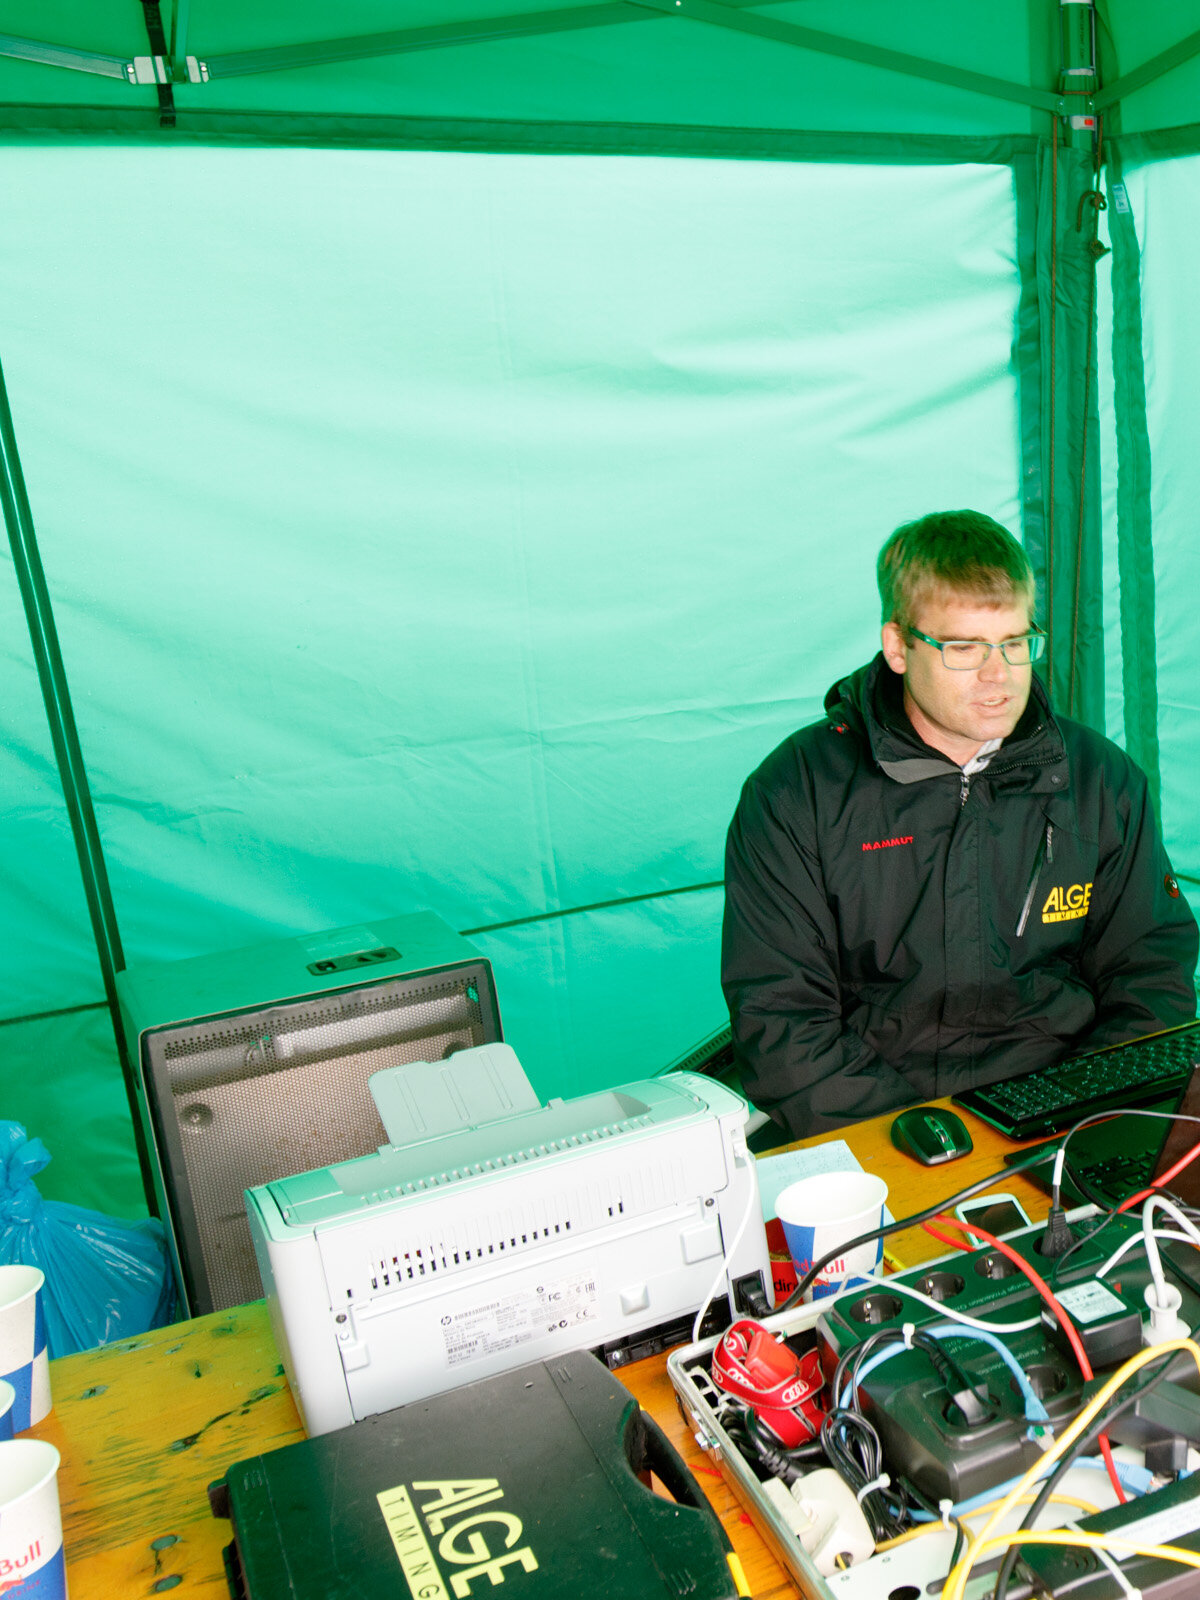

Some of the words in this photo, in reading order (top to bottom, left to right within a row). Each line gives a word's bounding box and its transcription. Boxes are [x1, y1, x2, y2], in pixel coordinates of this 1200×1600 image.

[862, 836, 914, 851] MAMMUT
[1042, 883, 1093, 912] ALGE
[794, 1258, 810, 1273] ed
[384, 1496, 441, 1599] TIMING
[411, 1478, 539, 1599] ALGE
[0, 1540, 41, 1577] Bull
